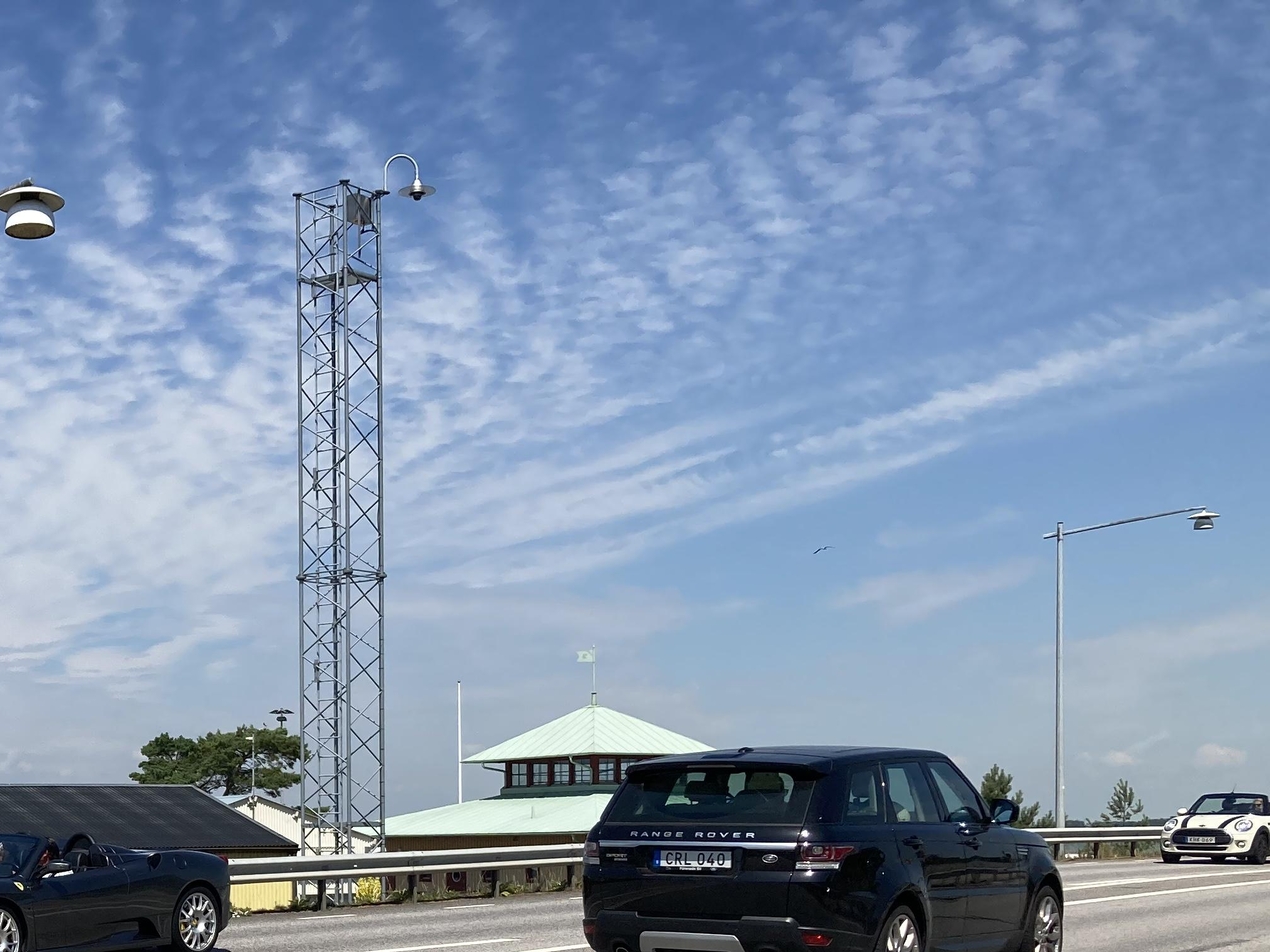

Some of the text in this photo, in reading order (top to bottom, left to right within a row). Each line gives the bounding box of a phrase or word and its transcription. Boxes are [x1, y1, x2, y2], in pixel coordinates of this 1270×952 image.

[694, 831, 756, 839] ROVER
[665, 851, 726, 866] CRL 040
